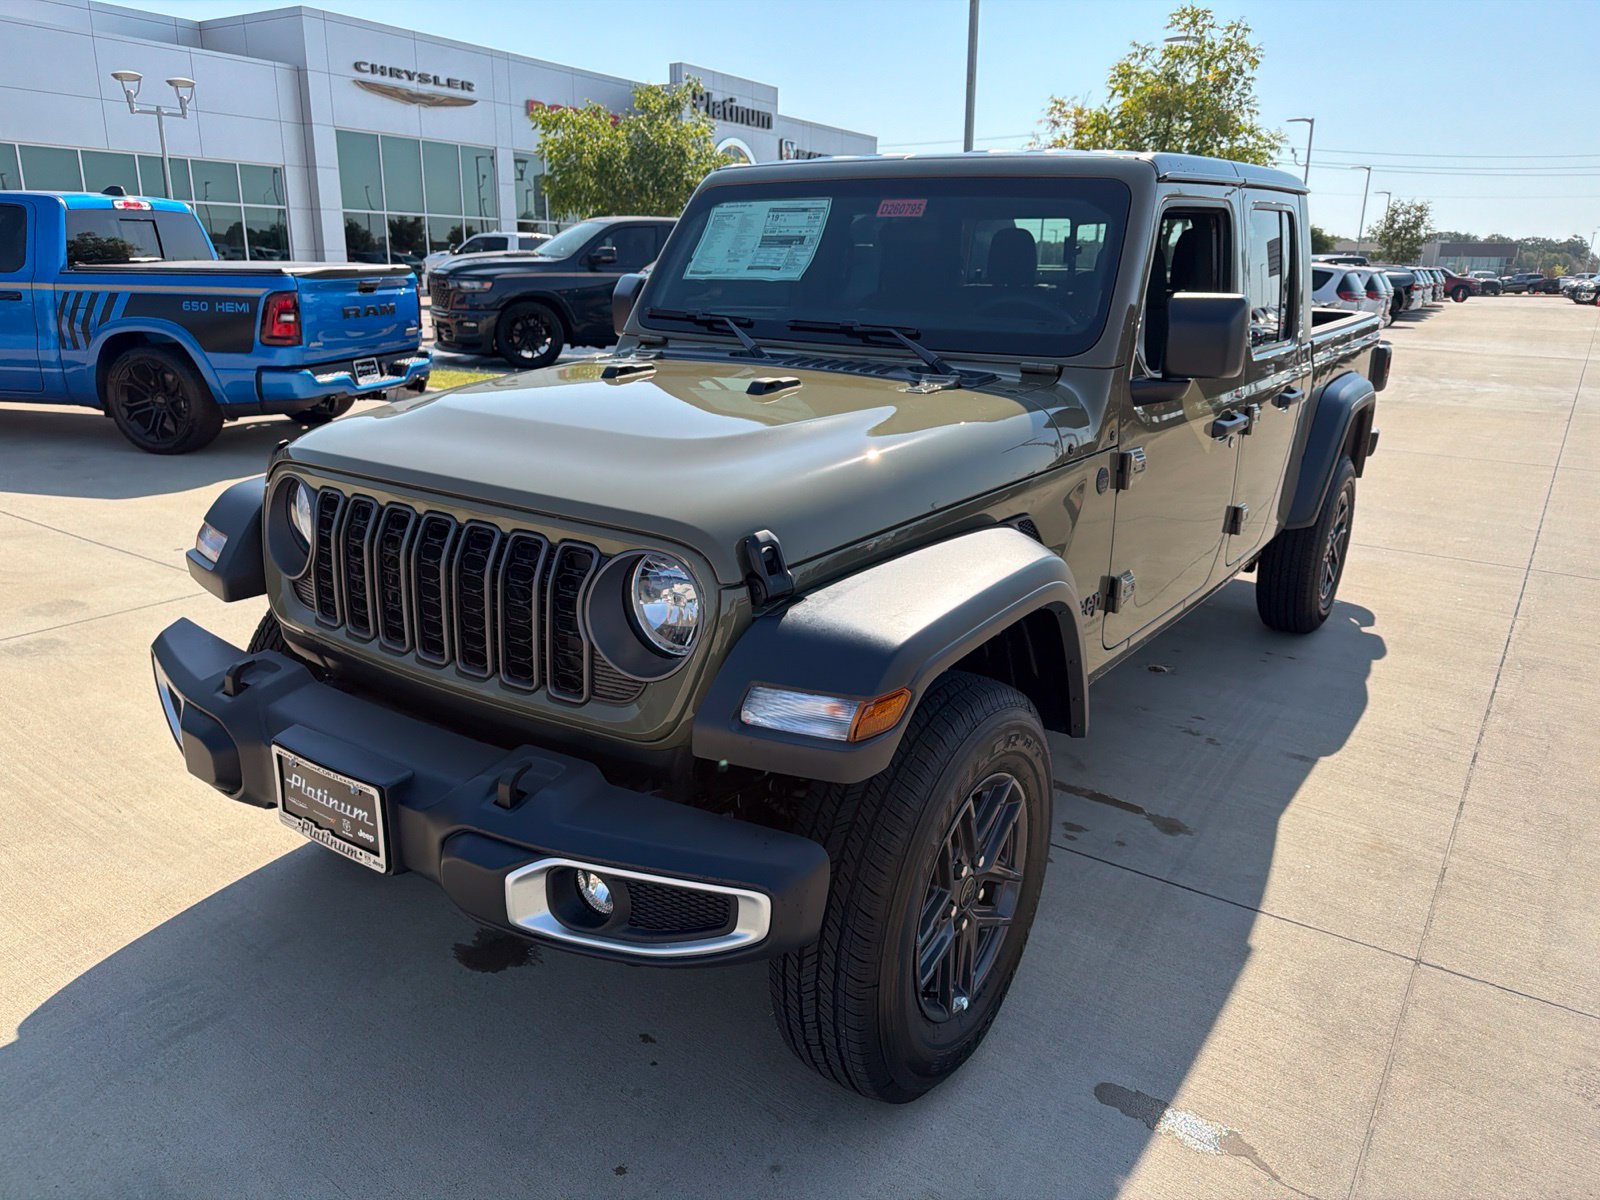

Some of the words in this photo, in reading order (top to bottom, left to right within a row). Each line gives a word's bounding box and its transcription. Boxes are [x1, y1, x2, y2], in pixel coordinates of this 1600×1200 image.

[353, 61, 475, 92] CHRYSLER
[691, 91, 773, 130] Platinum
[879, 202, 924, 216] D260795
[182, 300, 209, 312] 650
[215, 301, 250, 313] HEMI
[342, 303, 397, 319] RAM
[285, 773, 374, 826] Platinum
[301, 821, 362, 861] Platinum
[357, 828, 375, 843] Jeep
